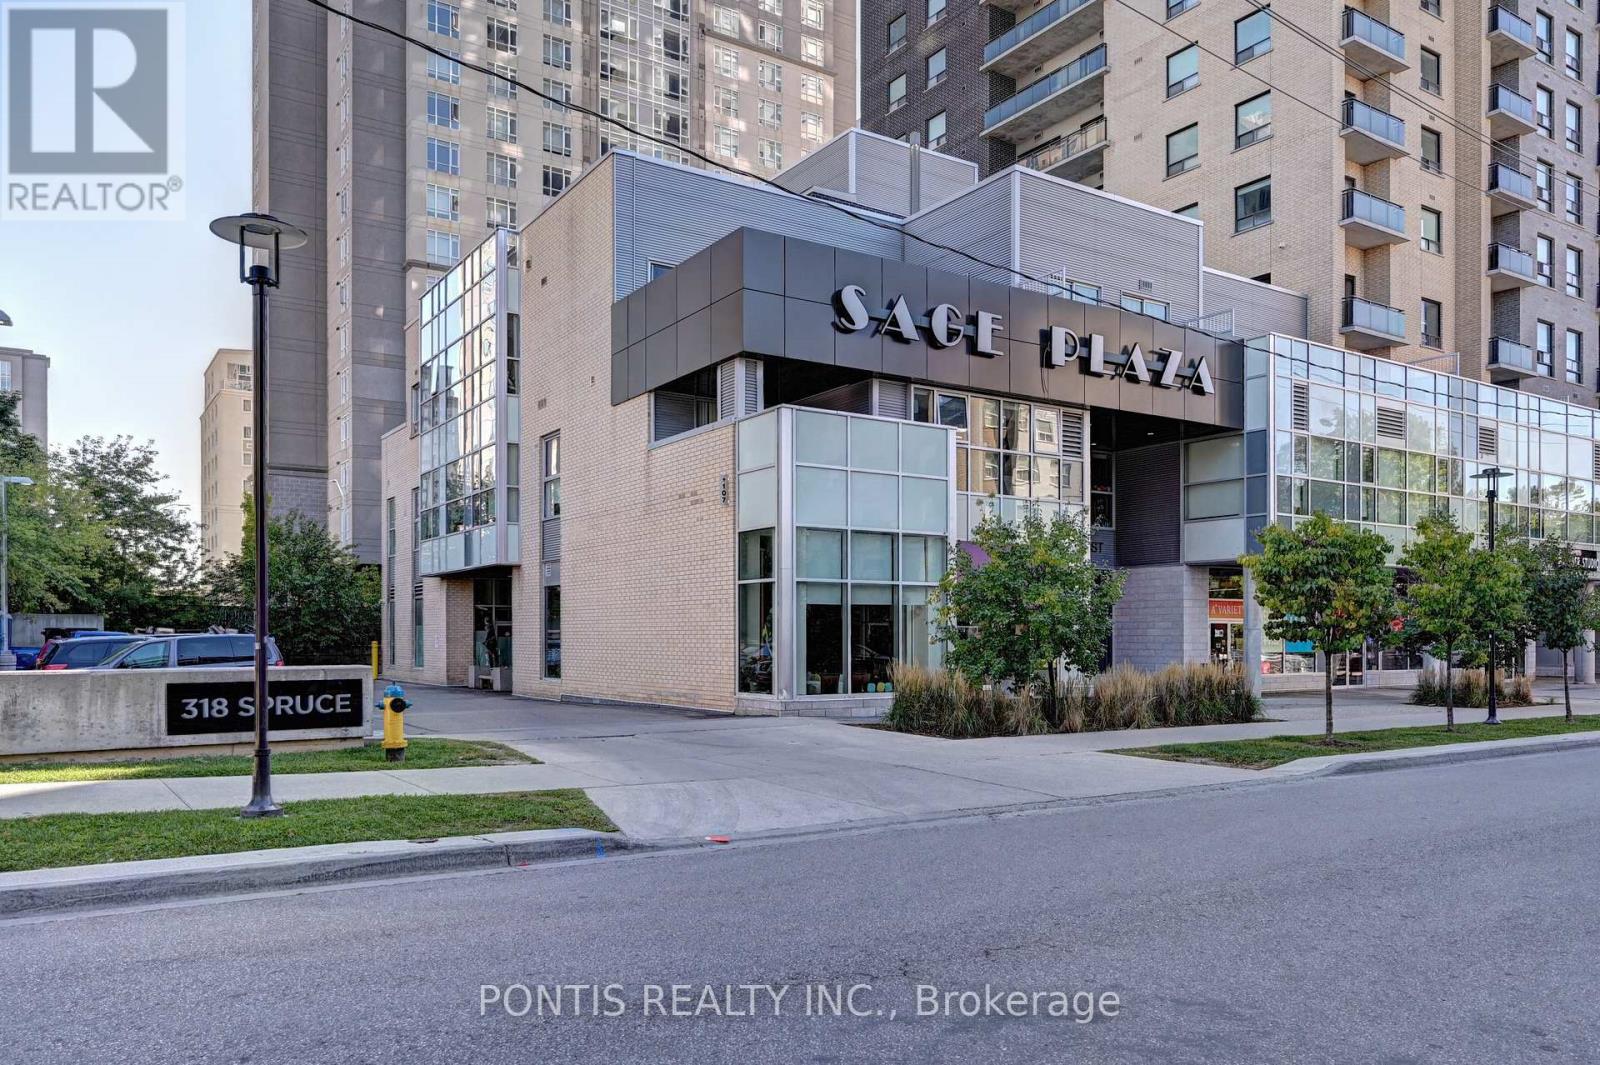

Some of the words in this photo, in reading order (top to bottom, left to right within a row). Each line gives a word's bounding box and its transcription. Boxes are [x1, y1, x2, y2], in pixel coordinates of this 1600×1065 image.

[833, 284, 1004, 358] SAGE
[1047, 325, 1215, 395] PLAZA
[180, 698, 229, 720] 318
